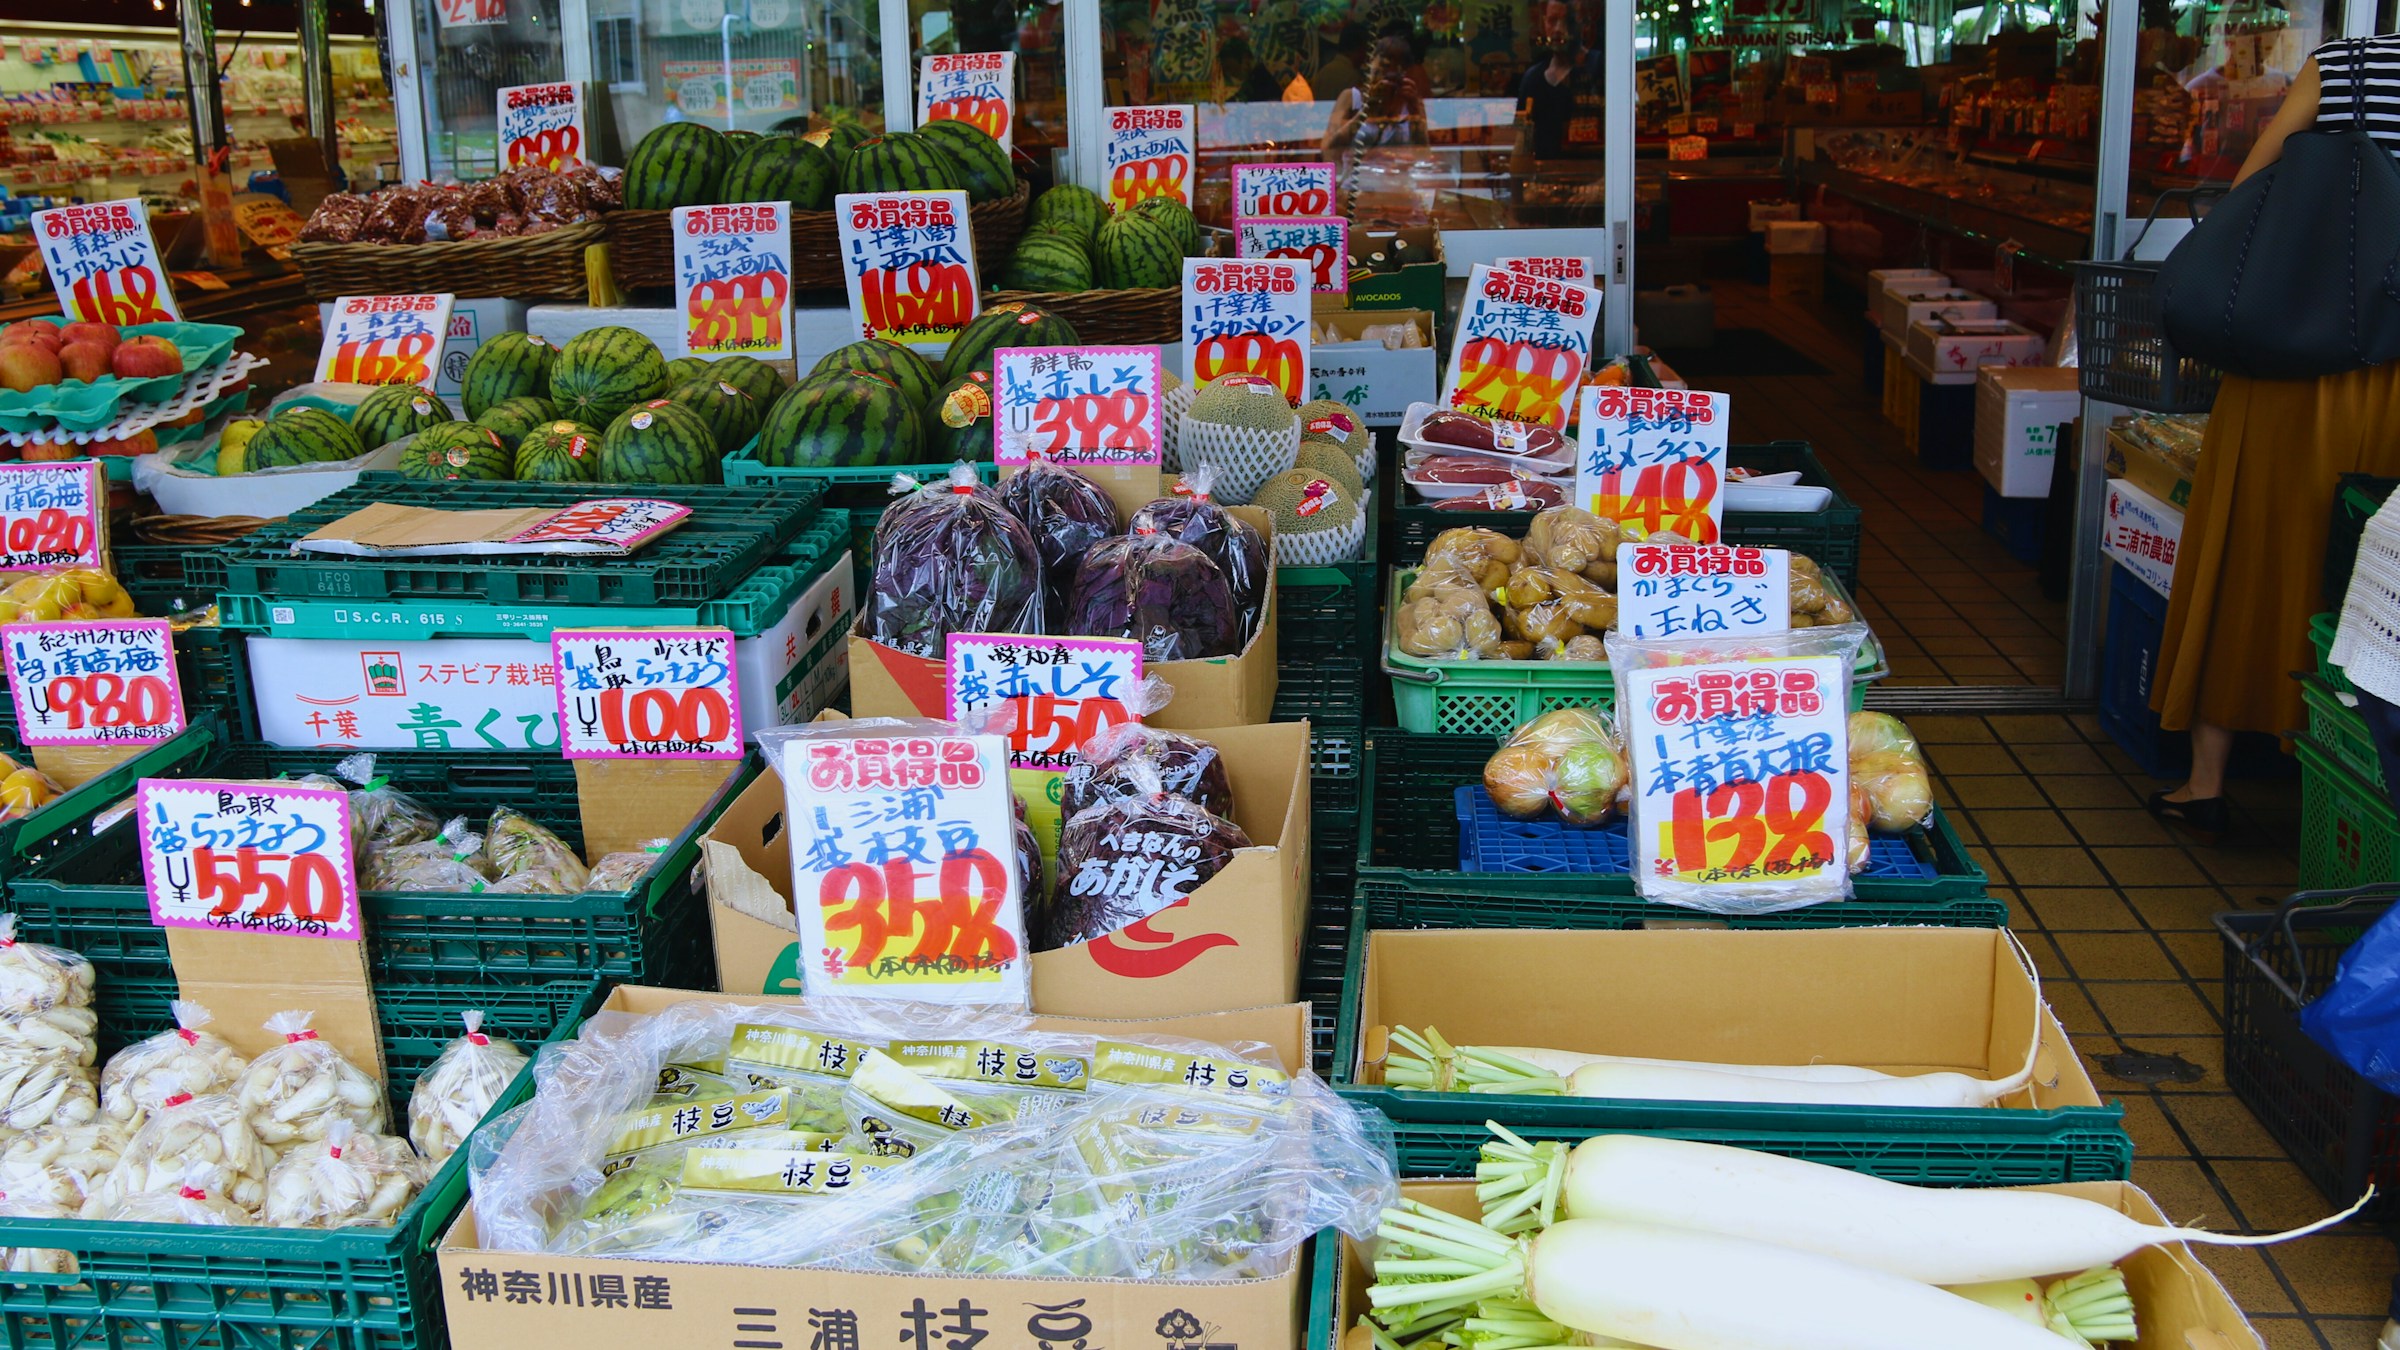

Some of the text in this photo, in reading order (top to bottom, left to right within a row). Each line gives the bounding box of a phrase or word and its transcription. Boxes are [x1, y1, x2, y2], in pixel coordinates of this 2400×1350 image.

[932, 54, 1004, 72] お買得品
[518, 117, 574, 138] ピーナッツ
[1111, 109, 1185, 131] お買得品
[851, 200, 957, 232] お買得品
[1258, 189, 1328, 215] 100
[43, 205, 136, 238] お買得品
[685, 205, 779, 235] お買得品
[1194, 263, 1298, 294] お買得品
[1508, 258, 1584, 278] お買得品
[73, 265, 176, 326] 168
[345, 296, 438, 315] お買得品
[861, 260, 974, 332] 1680
[1205, 295, 1276, 317] 千葉産
[1355, 293, 1402, 303] AVOCADOS
[1485, 271, 1586, 316] お買得品
[334, 332, 436, 386] 168
[1030, 352, 1093, 376] 群馬
[1041, 365, 1147, 401] 赤しそ
[1460, 336, 1582, 430] 298
[1034, 388, 1153, 454] 398
[1599, 387, 1714, 424] お買得品
[1617, 411, 1700, 437] 長崎
[0, 466, 82, 486] 州みなべ
[1600, 455, 1718, 545] 148
[1634, 544, 1765, 576] お買得品
[2116, 525, 2177, 567] 三浦市農協
[1632, 574, 1733, 599] かまくら
[419, 613, 446, 626] 615
[53, 645, 164, 676] 南高梅
[418, 662, 556, 688] ステビア栽培
[635, 653, 729, 688] らっきょう
[994, 660, 1121, 700] 赤しそ
[1653, 671, 1824, 724] お買得品
[48, 673, 172, 730] 980
[599, 687, 732, 745] 100
[304, 709, 363, 740] 千葉
[1681, 712, 1787, 749] 千葉産
[808, 740, 983, 789] お買得品
[217, 789, 278, 817] 鳥取
[850, 785, 945, 828] 三浦
[191, 812, 327, 855] らっきょう
[1672, 771, 1834, 874] 138
[860, 820, 987, 866] 枝豆
[192, 845, 345, 923] 550
[1069, 857, 1200, 915] あかしそ
[819, 847, 1018, 968] 358
[745, 1028, 811, 1051] 神奈川県産
[901, 1044, 1040, 1080] 神奈川県産 枝豆
[1107, 1047, 1176, 1073] 神奈川県産
[672, 1101, 736, 1135] 枝豆
[460, 1267, 674, 1311] 神奈川県産
[733, 1306, 862, 1350] 三浦
